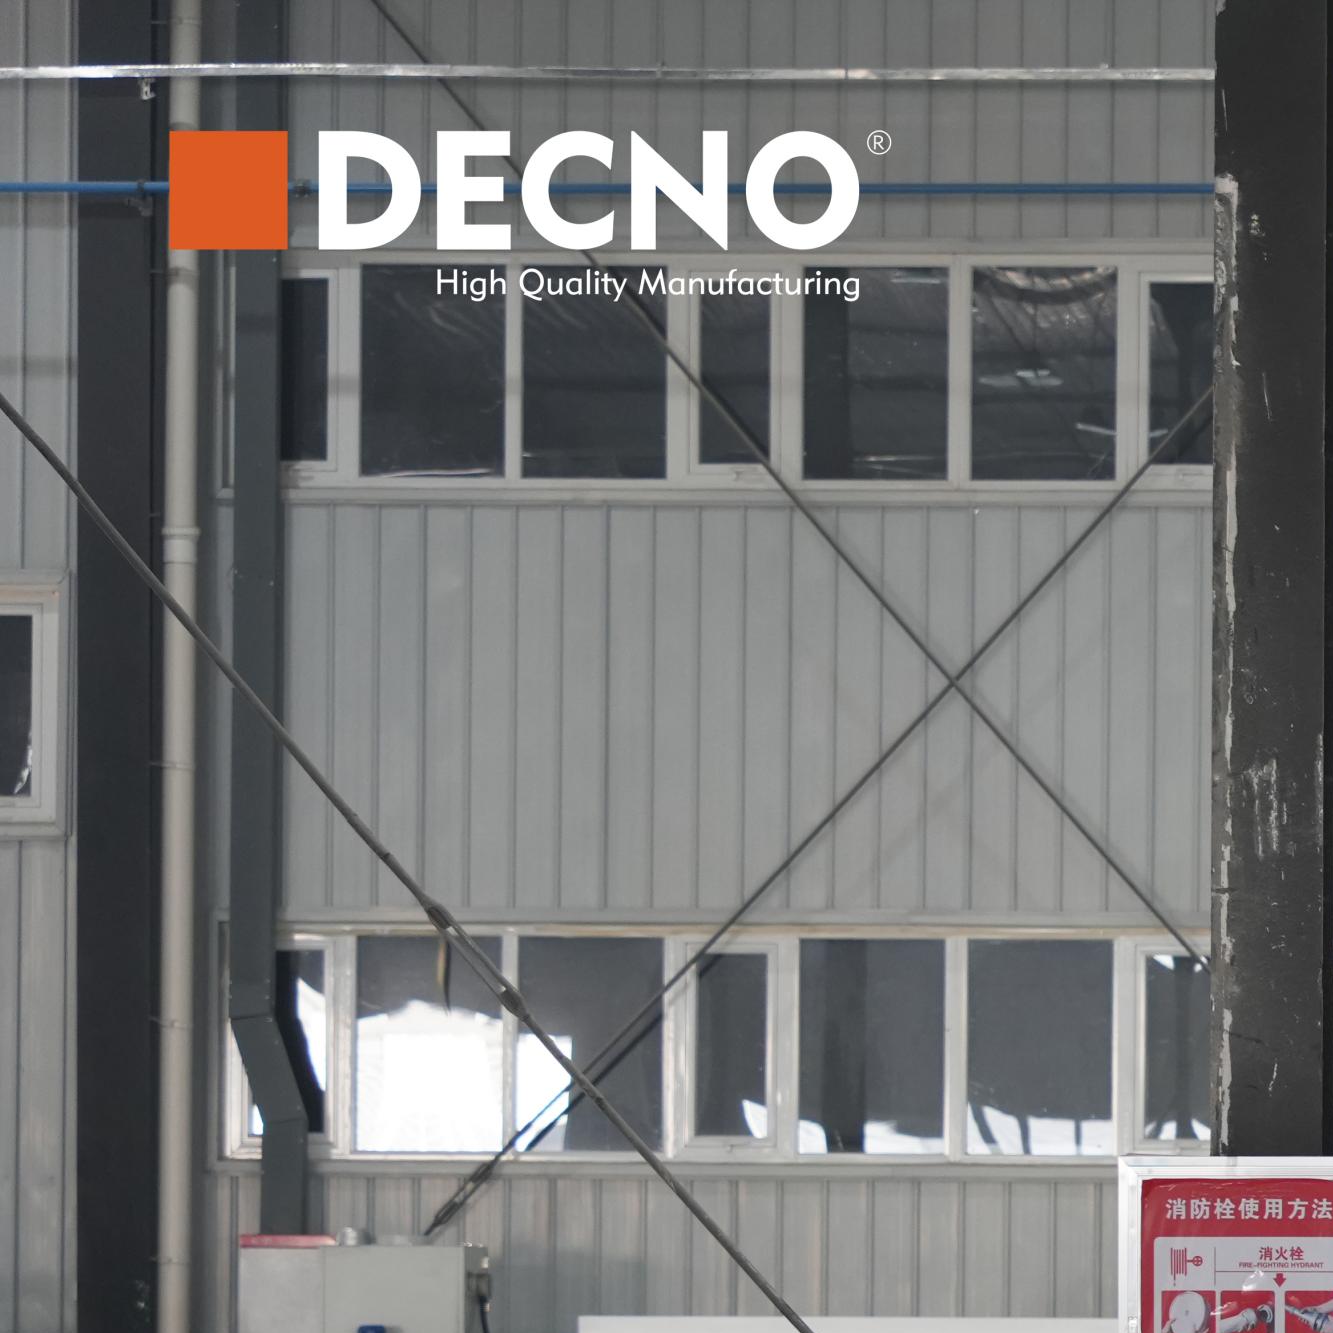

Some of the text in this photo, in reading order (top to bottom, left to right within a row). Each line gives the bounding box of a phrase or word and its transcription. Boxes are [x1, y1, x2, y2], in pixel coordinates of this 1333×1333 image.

[1165, 1198, 1333, 1220] 消防栓使用方法
[1258, 1246, 1305, 1261] 消火栓
